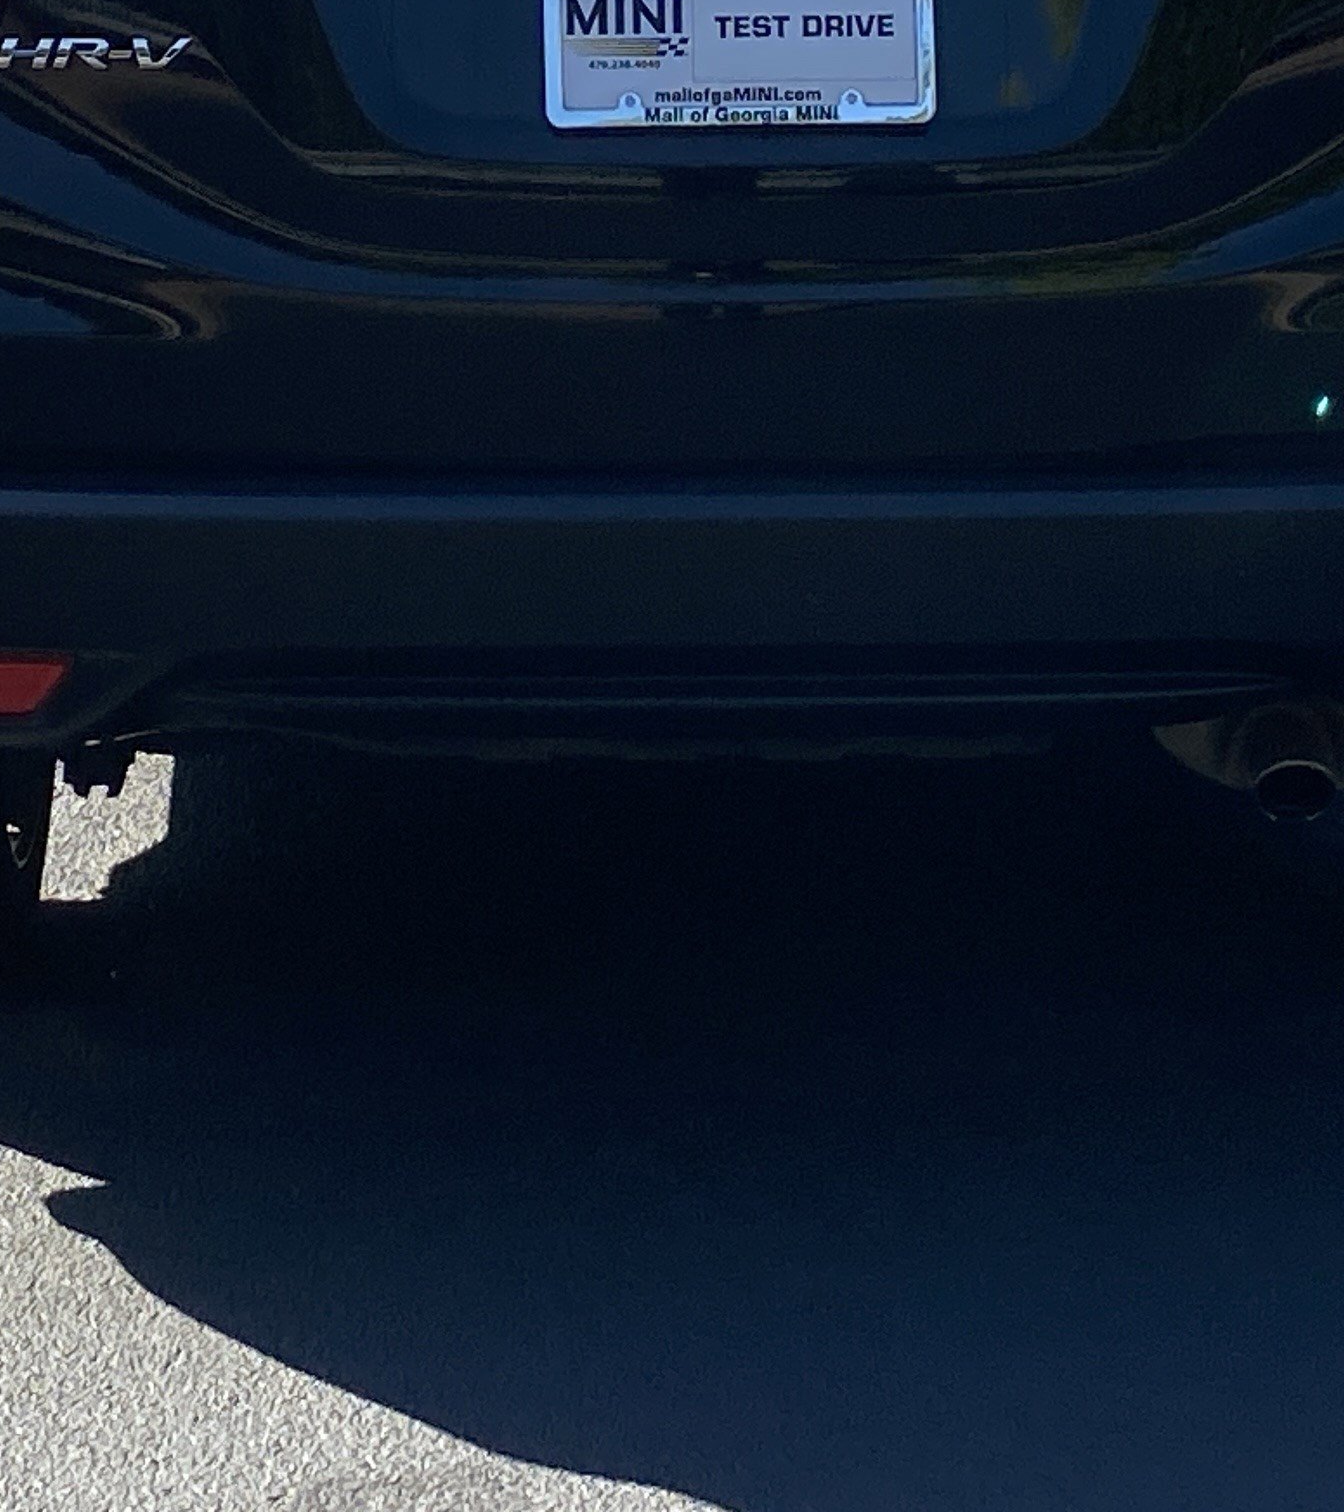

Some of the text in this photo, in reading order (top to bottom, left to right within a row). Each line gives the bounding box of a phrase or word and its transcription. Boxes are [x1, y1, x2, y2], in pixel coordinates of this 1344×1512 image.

[714, 14, 895, 39] TEST DRIVE
[654, 86, 822, 105] mallofgaMINI.com
[644, 105, 839, 124] Mall of Georgia MINI
